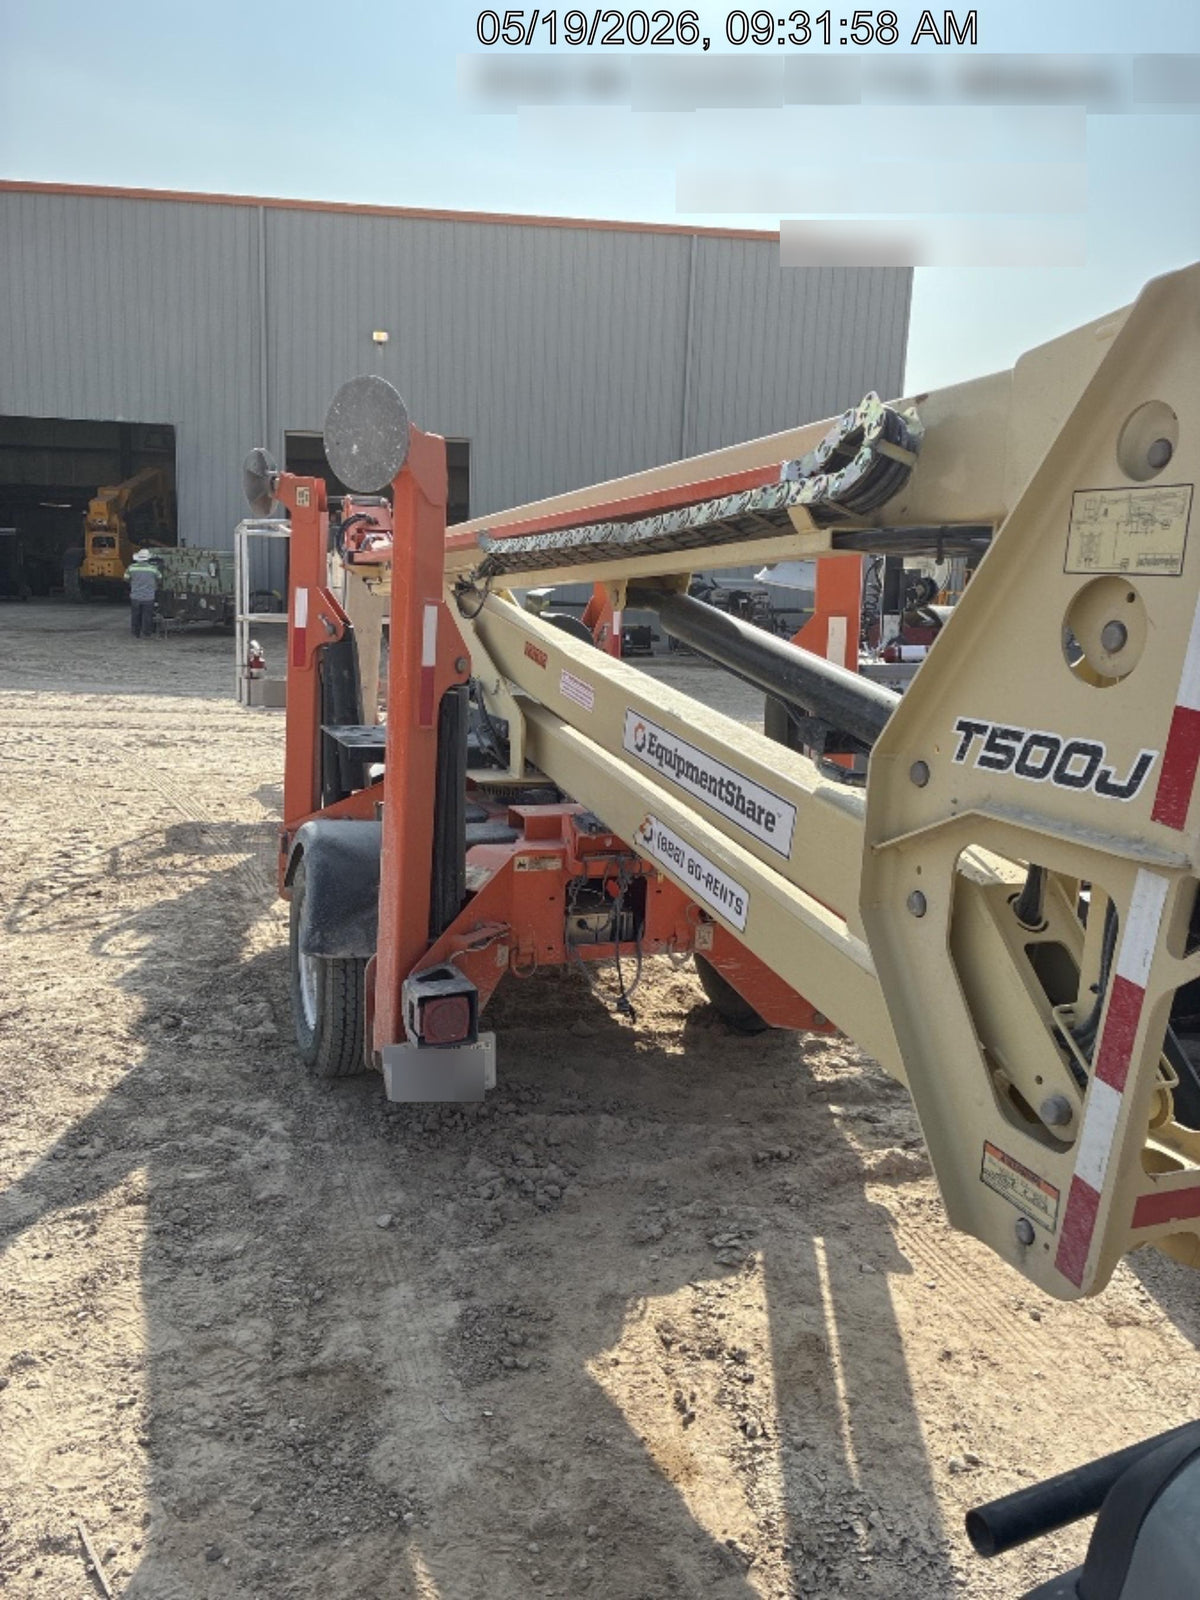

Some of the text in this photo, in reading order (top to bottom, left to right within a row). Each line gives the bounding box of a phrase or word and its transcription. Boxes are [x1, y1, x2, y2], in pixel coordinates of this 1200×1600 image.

[647, 732, 776, 833] EquipmentShare
[954, 718, 1157, 800] T500J
[687, 859, 744, 917] 60-RENTS
